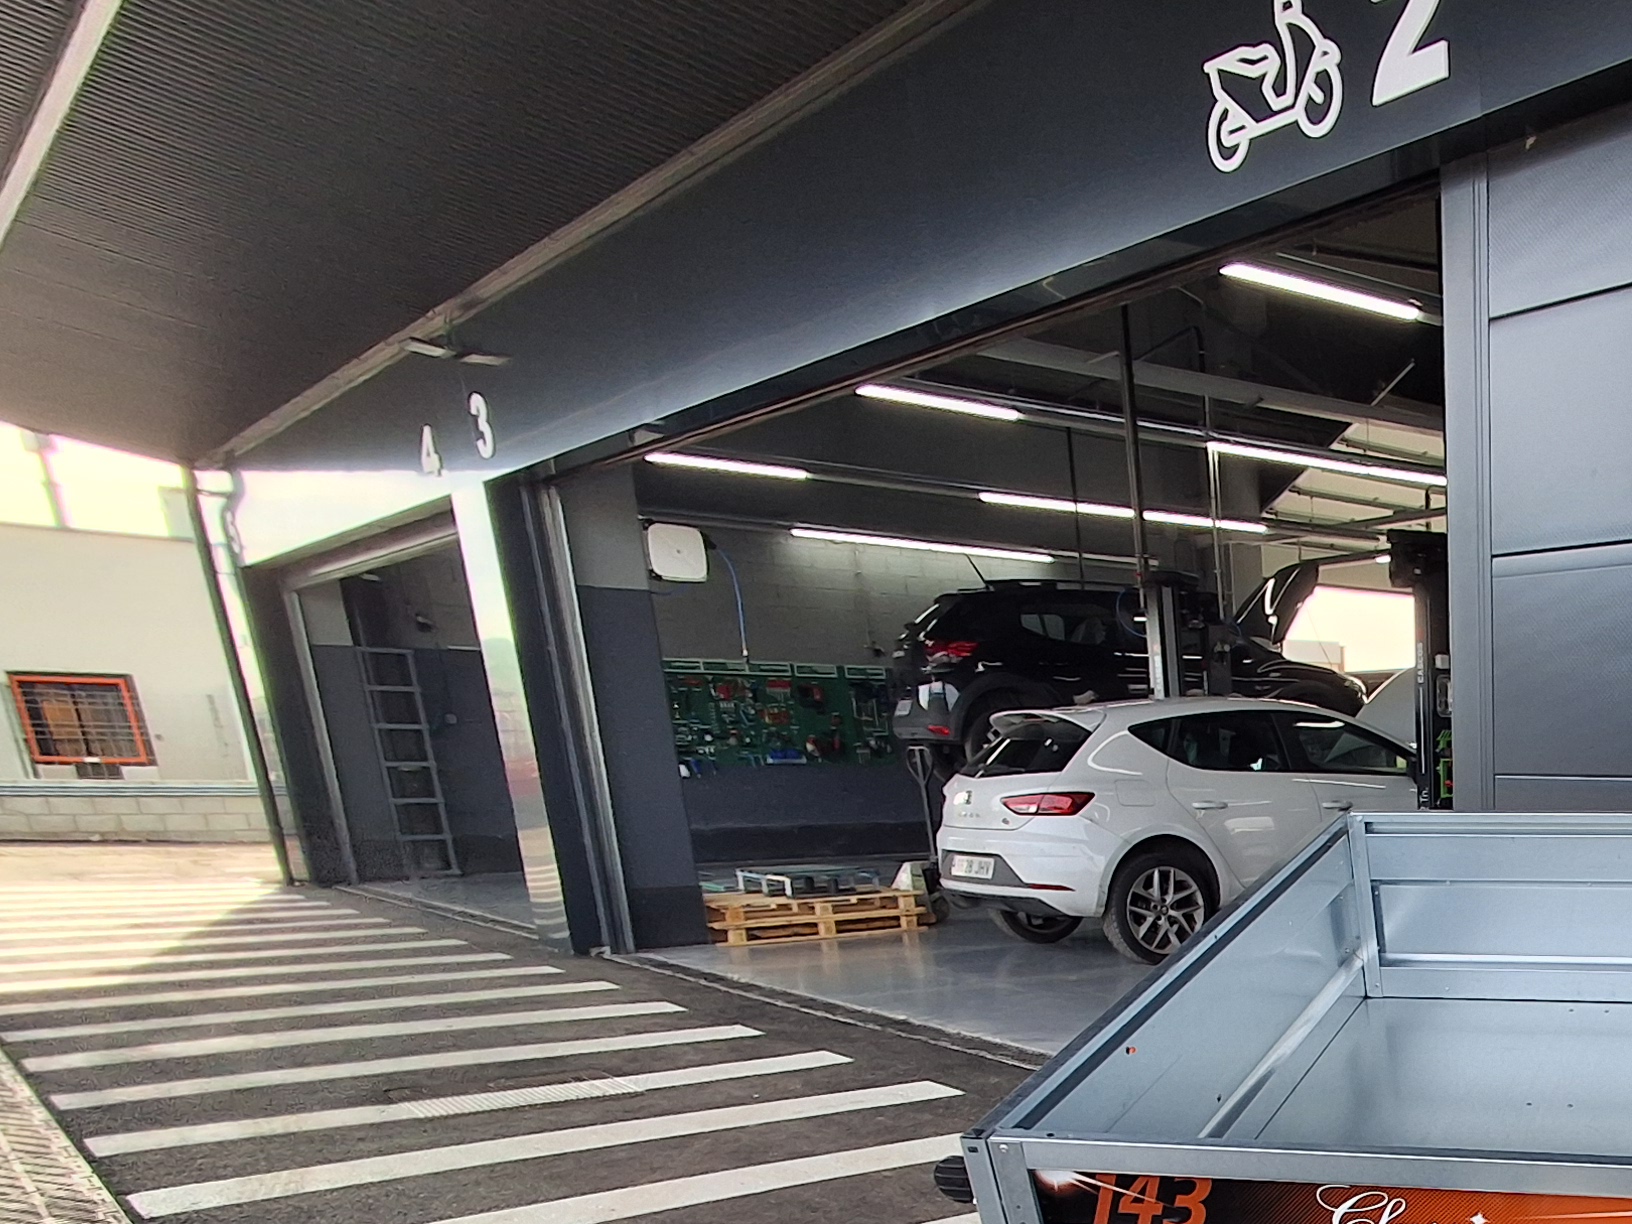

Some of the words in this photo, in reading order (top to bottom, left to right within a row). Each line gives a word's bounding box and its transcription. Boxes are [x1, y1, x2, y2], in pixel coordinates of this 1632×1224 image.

[1372, 0, 1449, 106] 2
[421, 425, 441, 474] 4
[469, 392, 494, 459] 3
